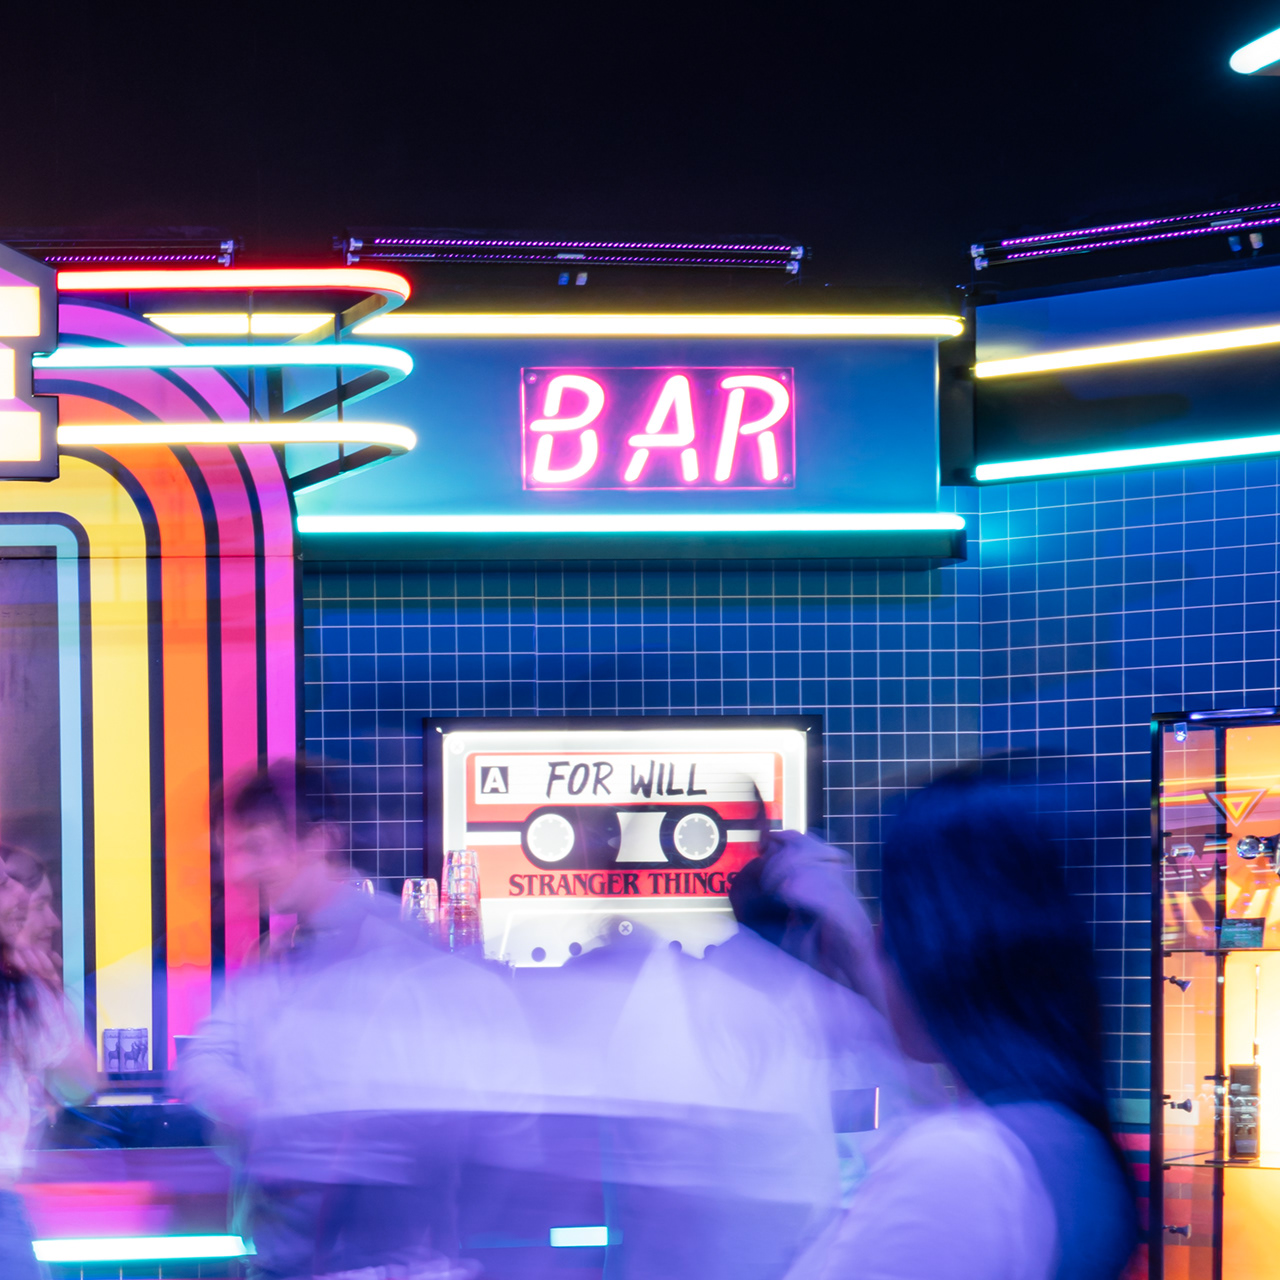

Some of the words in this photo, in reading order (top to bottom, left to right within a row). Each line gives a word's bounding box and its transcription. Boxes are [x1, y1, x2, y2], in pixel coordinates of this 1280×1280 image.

[528, 373, 790, 484] BAR
[482, 767, 508, 793] A
[545, 760, 614, 799] FOR
[630, 759, 708, 799] WILL
[508, 872, 641, 896] STRANGER
